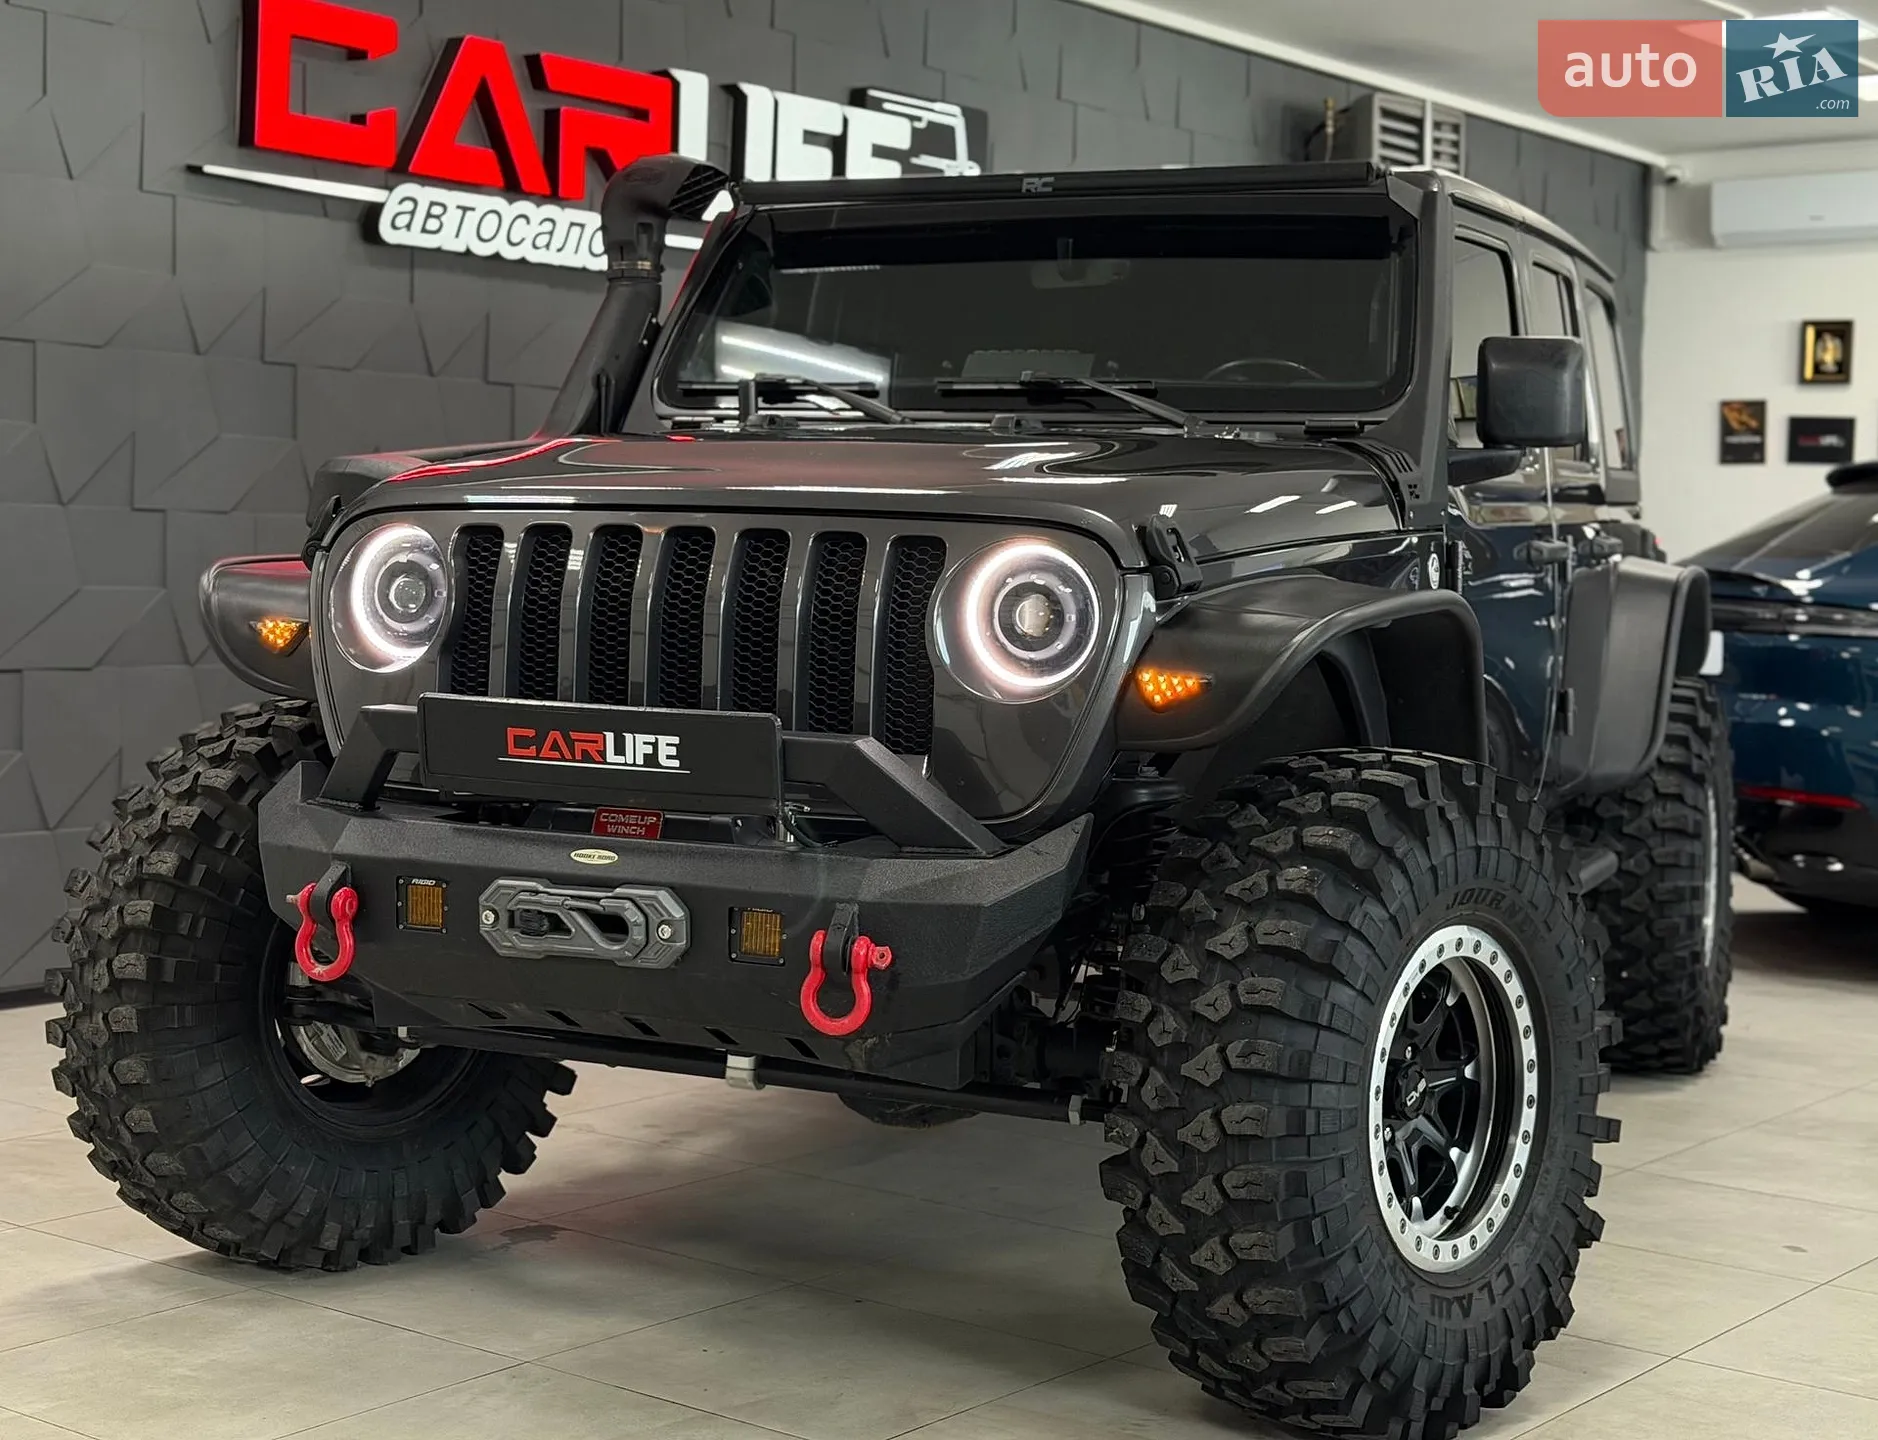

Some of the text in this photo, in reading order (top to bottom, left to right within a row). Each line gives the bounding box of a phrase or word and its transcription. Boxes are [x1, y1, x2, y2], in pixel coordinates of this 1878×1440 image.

[252, 0, 913, 220] CARLIFE
[1021, 176, 1056, 193] RC
[506, 726, 681, 768] CARLIFE
[600, 812, 657, 826] COMEUP
[607, 824, 646, 836] WINCH
